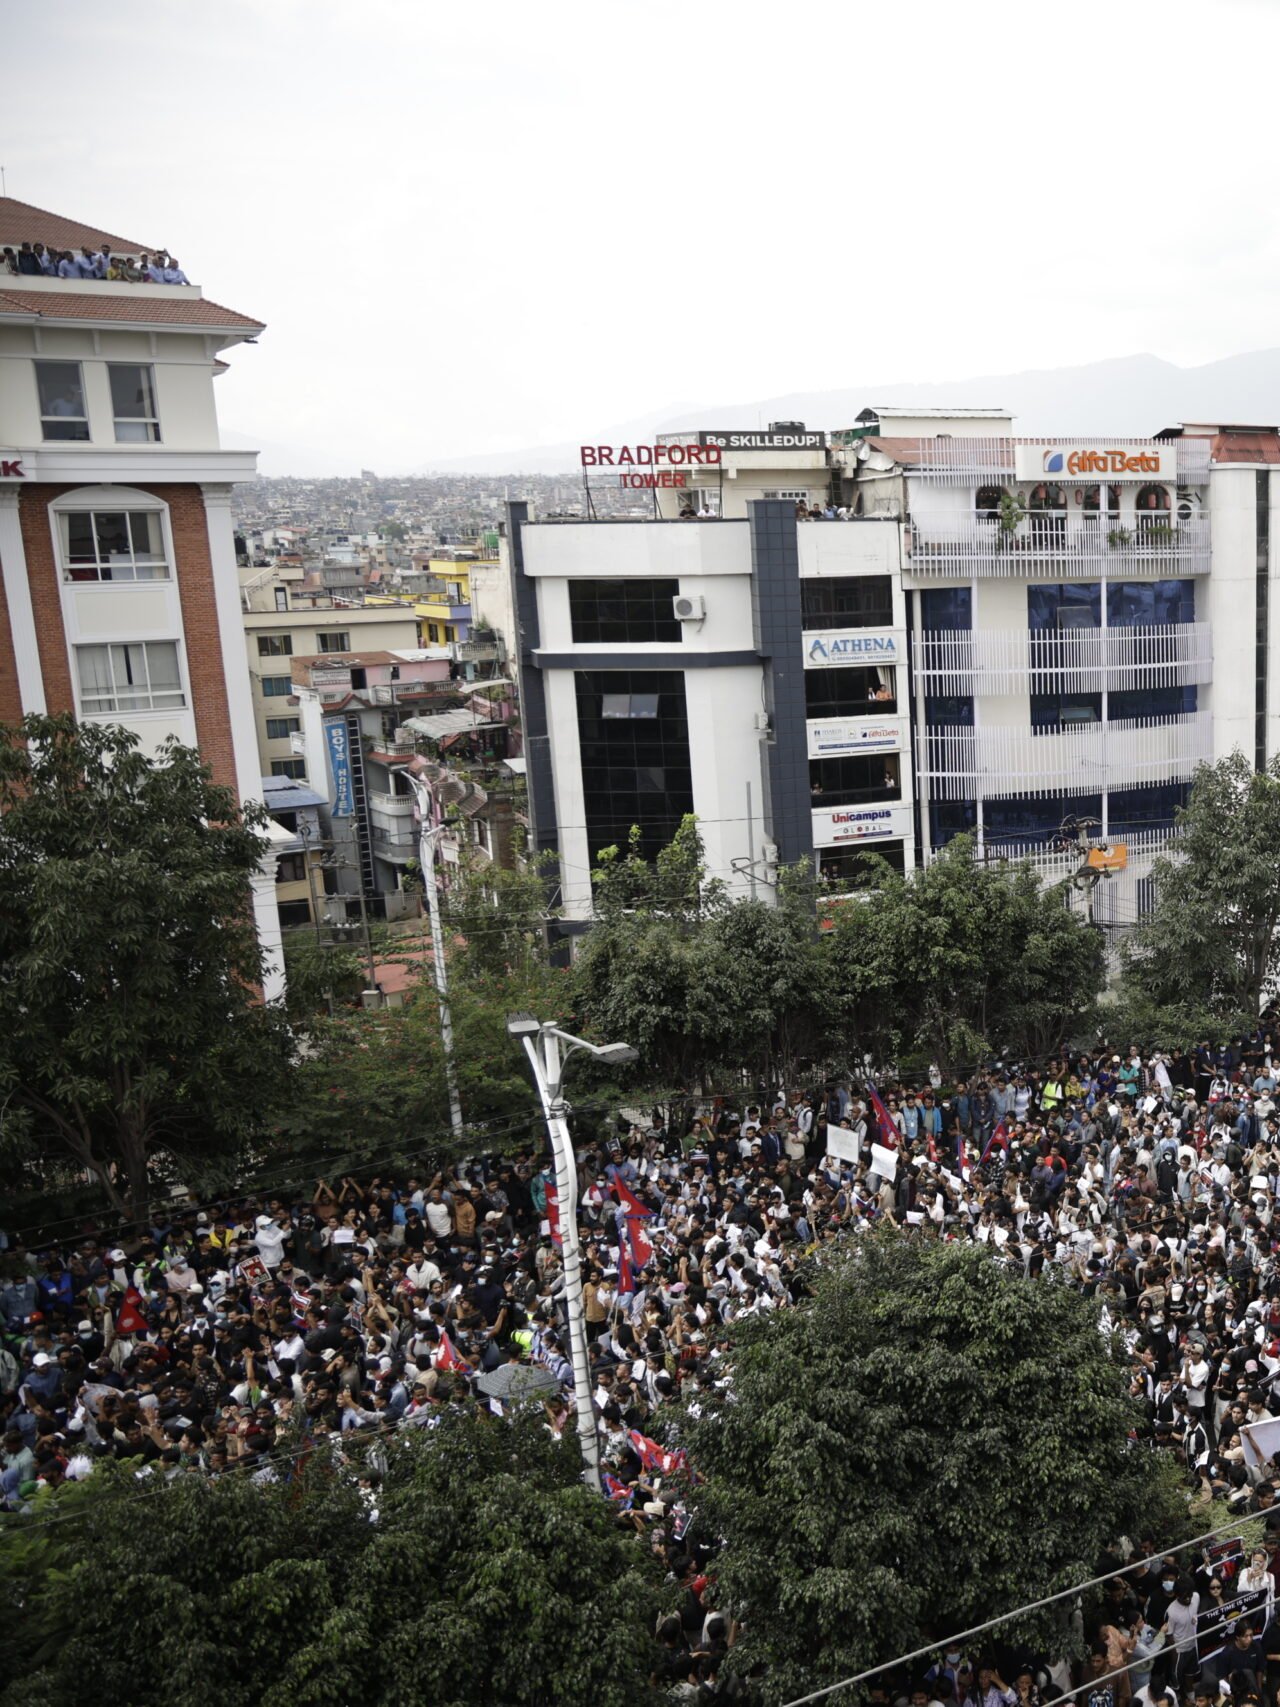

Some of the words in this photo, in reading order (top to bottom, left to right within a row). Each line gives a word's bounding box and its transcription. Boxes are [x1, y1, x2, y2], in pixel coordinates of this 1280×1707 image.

[706, 435, 727, 447] Be
[730, 435, 820, 447] SKILLEDUP!
[580, 445, 722, 465] BRADFORD
[619, 473, 687, 488] TOWER
[830, 637, 896, 653] ATHENA
[331, 728, 346, 761] BOYS
[337, 768, 350, 817] HOSTEL
[832, 810, 892, 824] Unicampus
[843, 825, 883, 834] GLOBAL
[1206, 1610, 1220, 1619] THE
[1220, 1603, 1236, 1614] TIME
[1244, 1593, 1260, 1603] NOW
